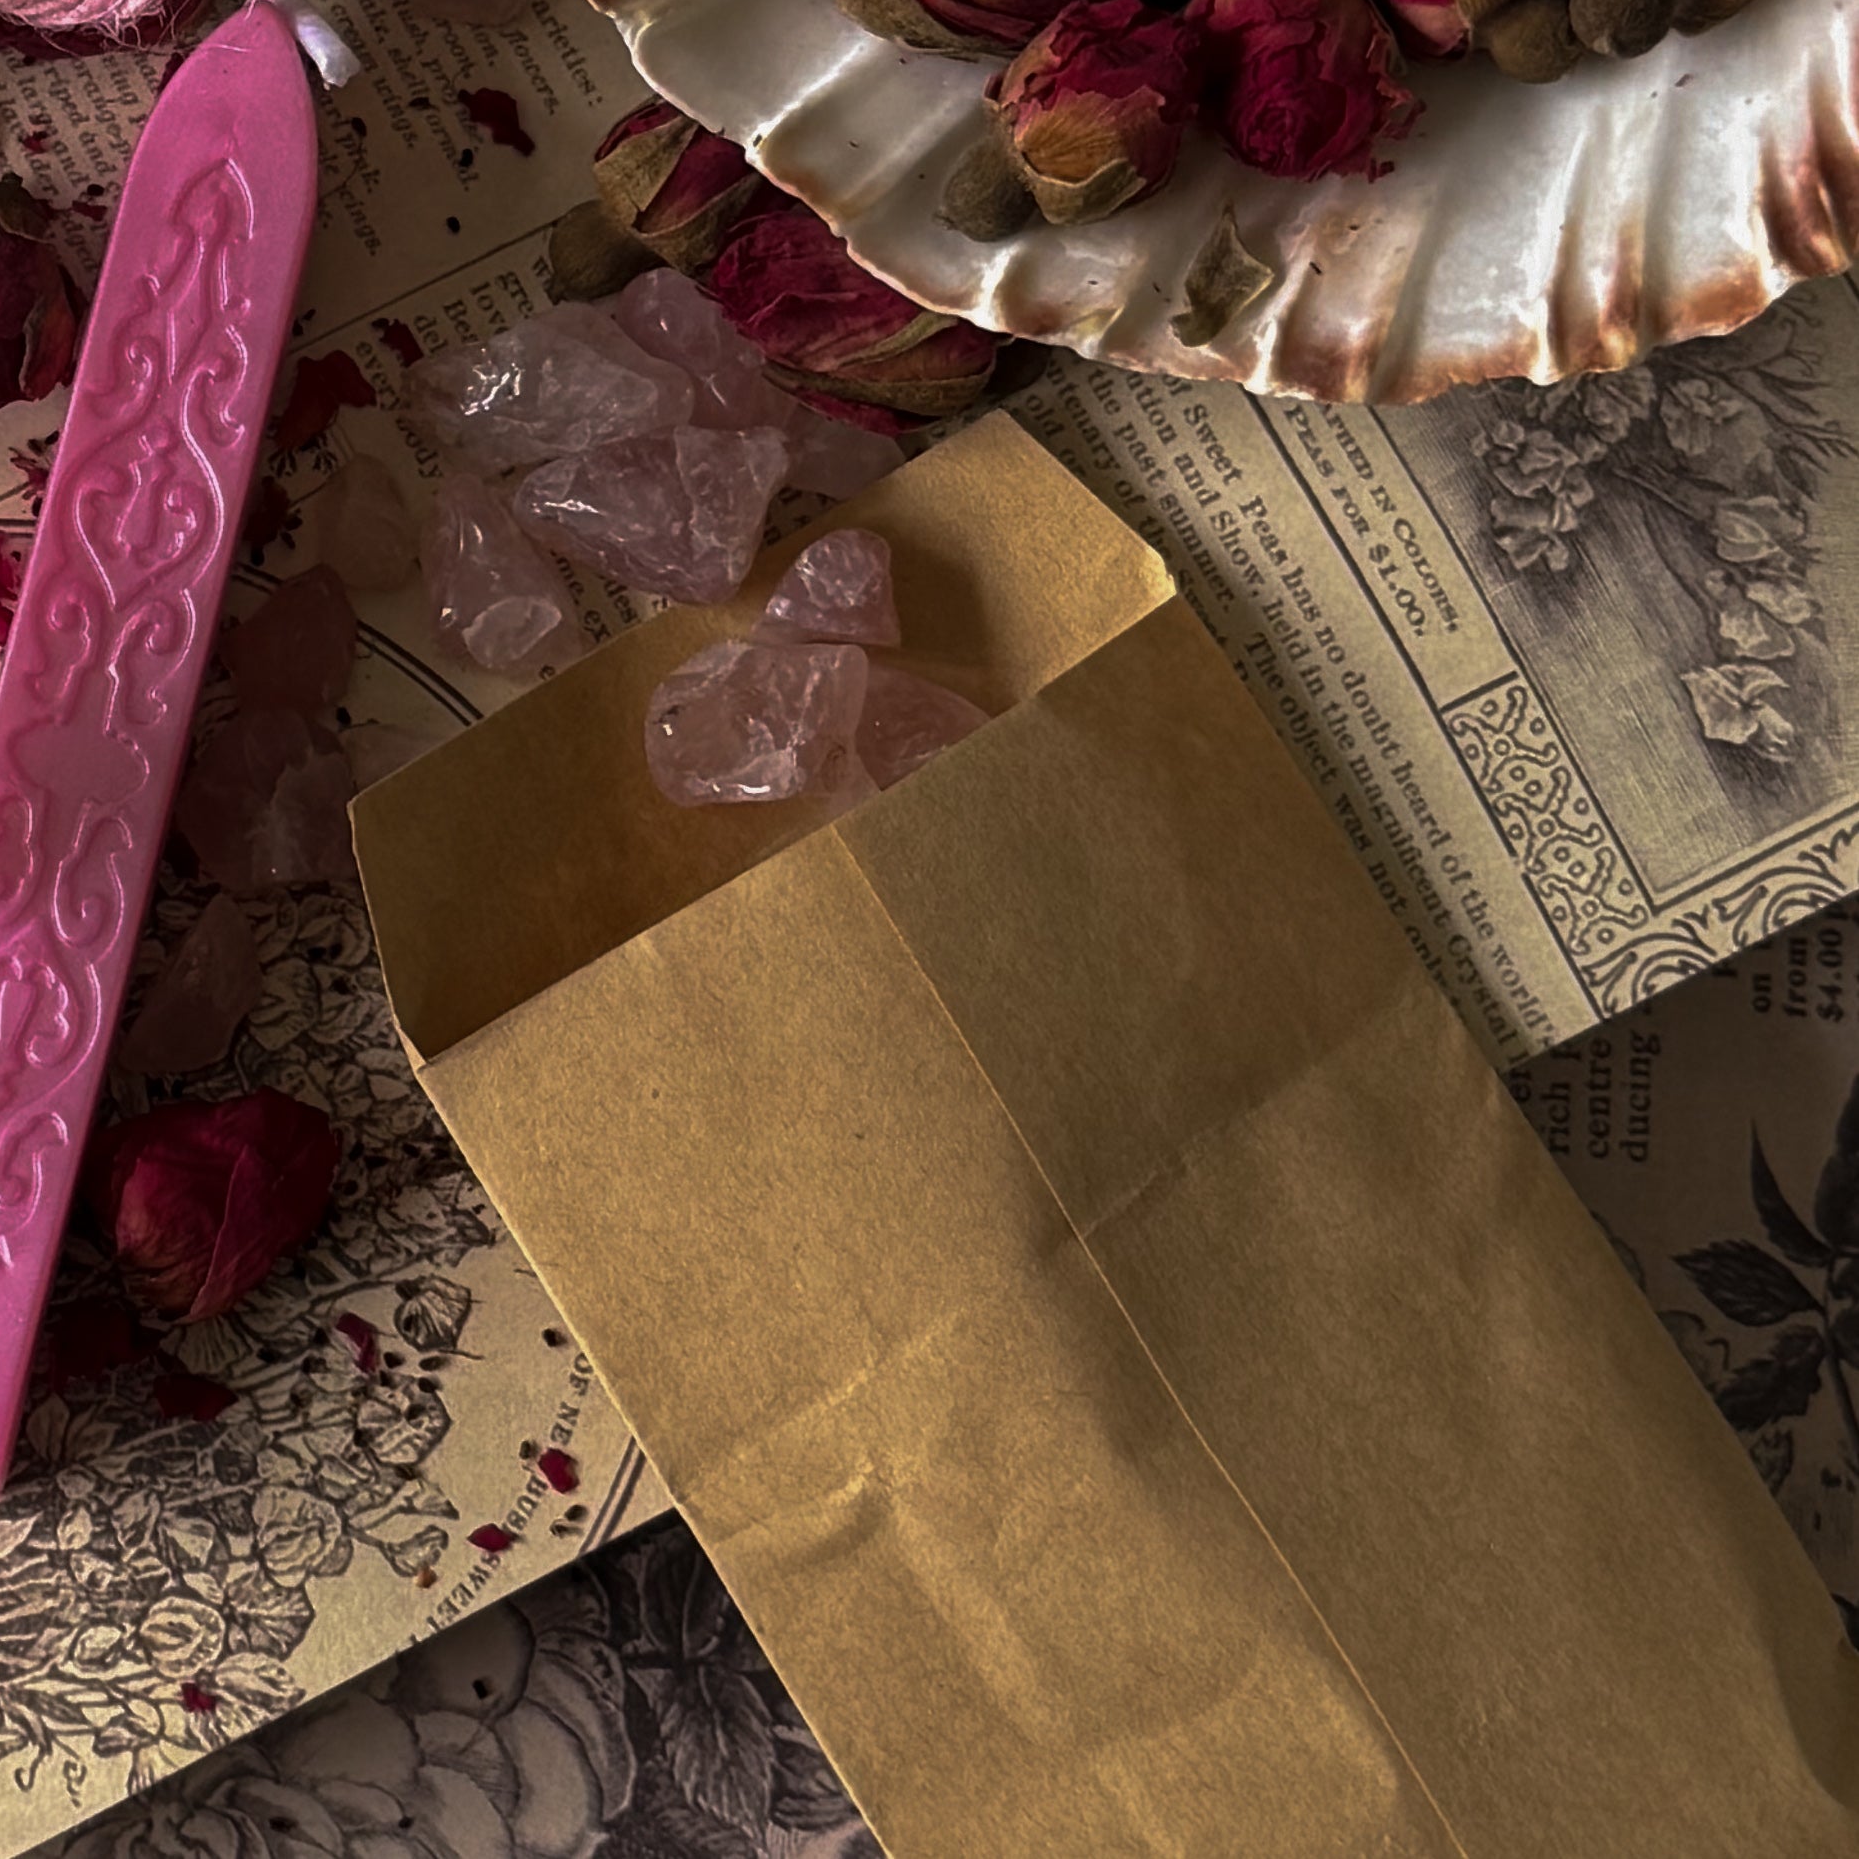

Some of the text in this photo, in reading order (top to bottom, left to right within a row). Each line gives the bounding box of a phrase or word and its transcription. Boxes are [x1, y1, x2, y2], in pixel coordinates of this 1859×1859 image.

[330, 4, 379, 74] cream
[372, 76, 419, 150] wings.
[431, 16, 476, 80] roon.
[498, 30, 560, 117] flowers.
[50, 140, 90, 188] and
[78, 131, 118, 177] and
[1026, 394, 1066, 438] old
[1114, 480, 1147, 508] of
[1368, 544, 1426, 637] $1.00.
[1087, 368, 1122, 415] the
[1112, 421, 1167, 488] past
[1158, 493, 1236, 614] summer.
[1244, 632, 1284, 690] The
[1279, 695, 1340, 786] object
[1334, 792, 1374, 852] was
[1366, 860, 1408, 918] not
[1182, 403, 1243, 487] Sweet
[1237, 495, 1288, 566] Peas
[1280, 566, 1325, 623] has
[1314, 626, 1346, 665] no
[1341, 670, 1402, 760] doubt
[1390, 760, 1453, 850] heard
[1440, 853, 1473, 886] of
[1460, 888, 1495, 940] the
[1173, 452, 1222, 509] and
[1208, 510, 1266, 598] Show,
[1260, 596, 1312, 664] held
[1298, 664, 1326, 699] in
[1321, 700, 1356, 750] the
[1347, 754, 1452, 929] magnificent
[1448, 934, 1519, 1046] Crystal
[1752, 973, 1772, 1013] on
[1781, 937, 1809, 1018] from
[1816, 928, 1845, 1024] $4.00
[1536, 1082, 1572, 1156] rich
[1583, 1034, 1612, 1160] centre
[1618, 1029, 1661, 1163] ducing
[569, 1351, 595, 1397] OF
[550, 1401, 581, 1446] NE
